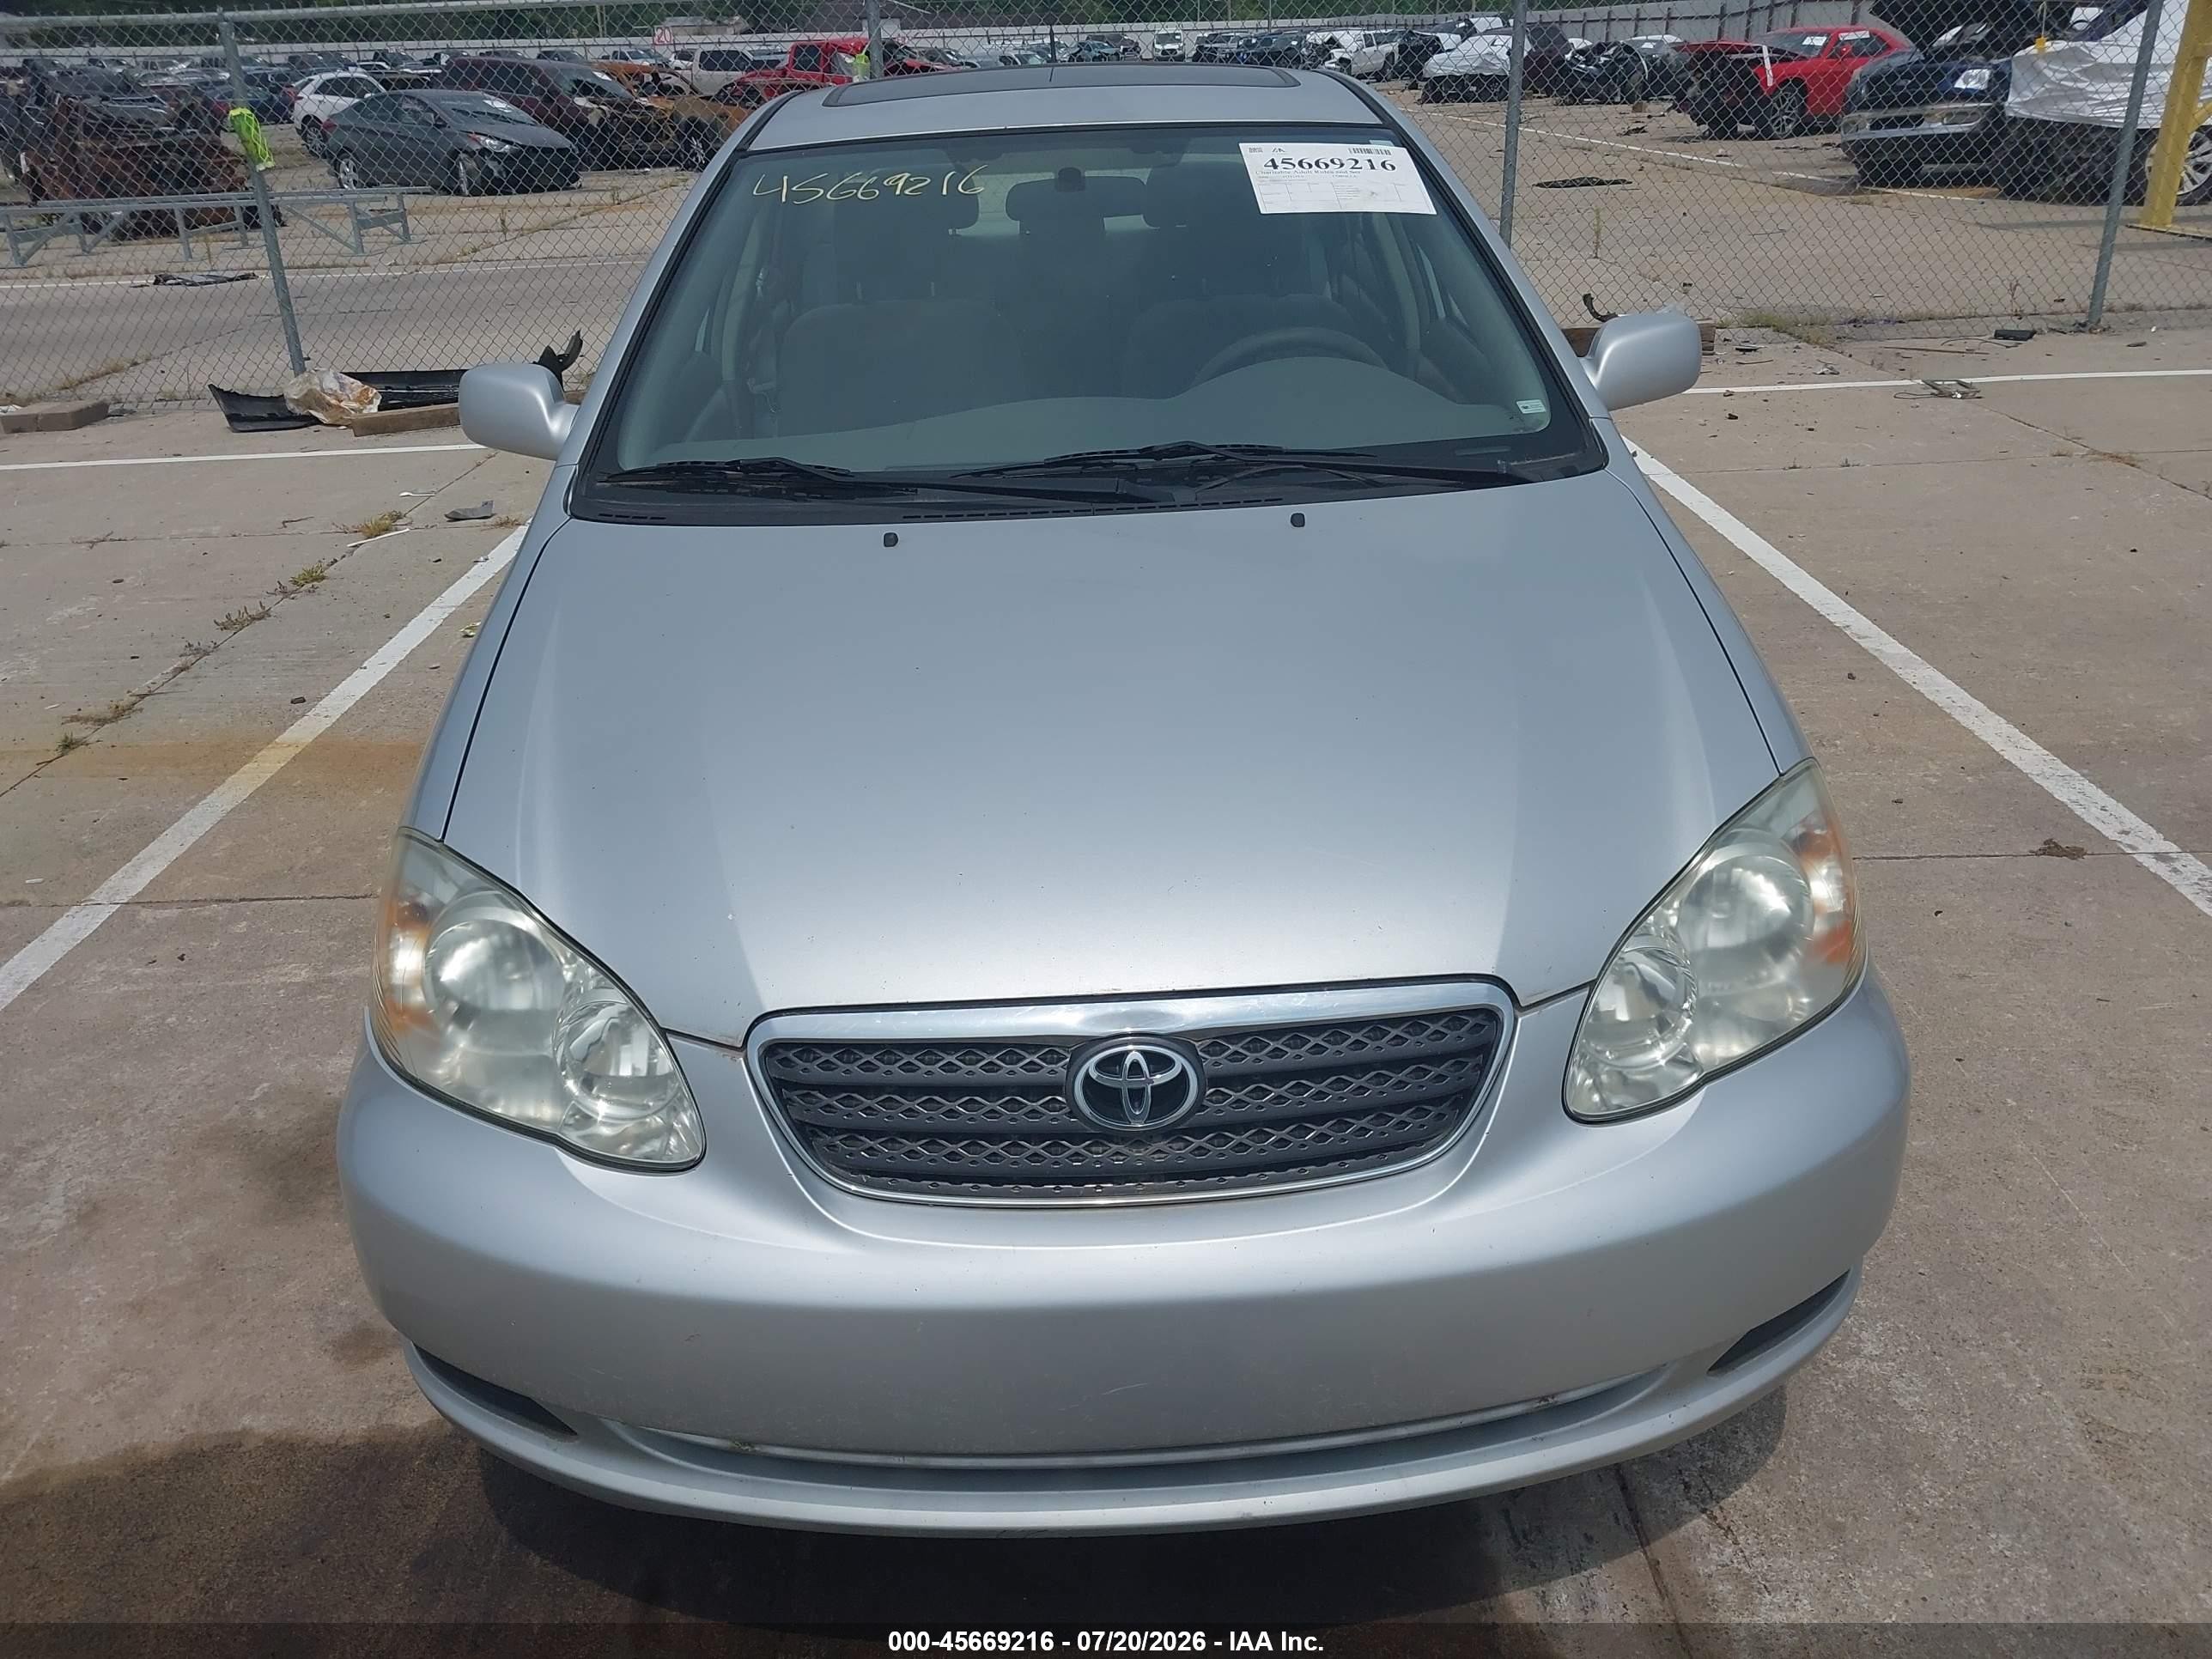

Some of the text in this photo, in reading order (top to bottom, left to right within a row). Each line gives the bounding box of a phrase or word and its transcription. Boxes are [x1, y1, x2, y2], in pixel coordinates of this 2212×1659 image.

[657, 27, 672, 42] 20
[1263, 157, 1396, 172] 45669216
[752, 165, 988, 204] 45669216
